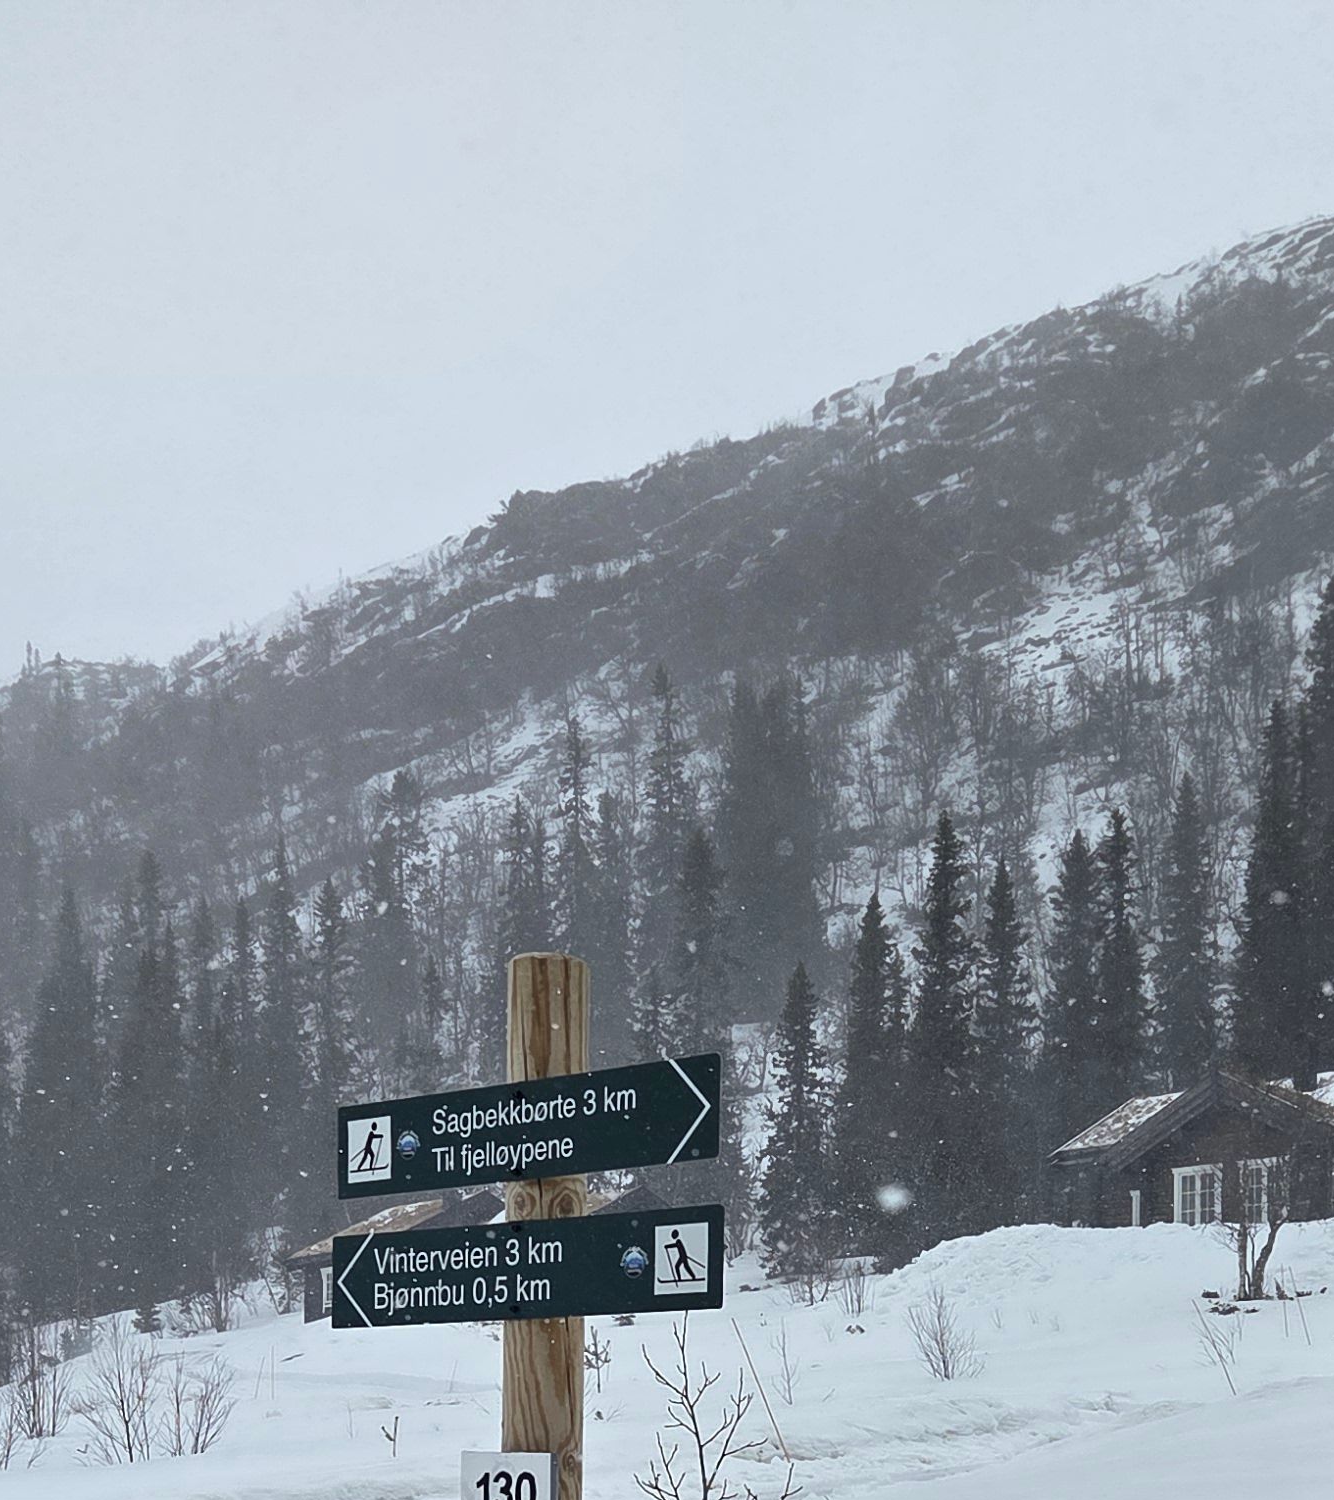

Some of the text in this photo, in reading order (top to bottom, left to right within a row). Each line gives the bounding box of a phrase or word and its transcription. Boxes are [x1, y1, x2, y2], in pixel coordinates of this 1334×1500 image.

[432, 1086, 637, 1138] Sagbekkbørte 3 km
[432, 1137, 574, 1176] Til fjelløypene
[373, 1236, 563, 1275] Vinterveien 3 km
[373, 1273, 551, 1317] Bjønnbu 0,5 km
